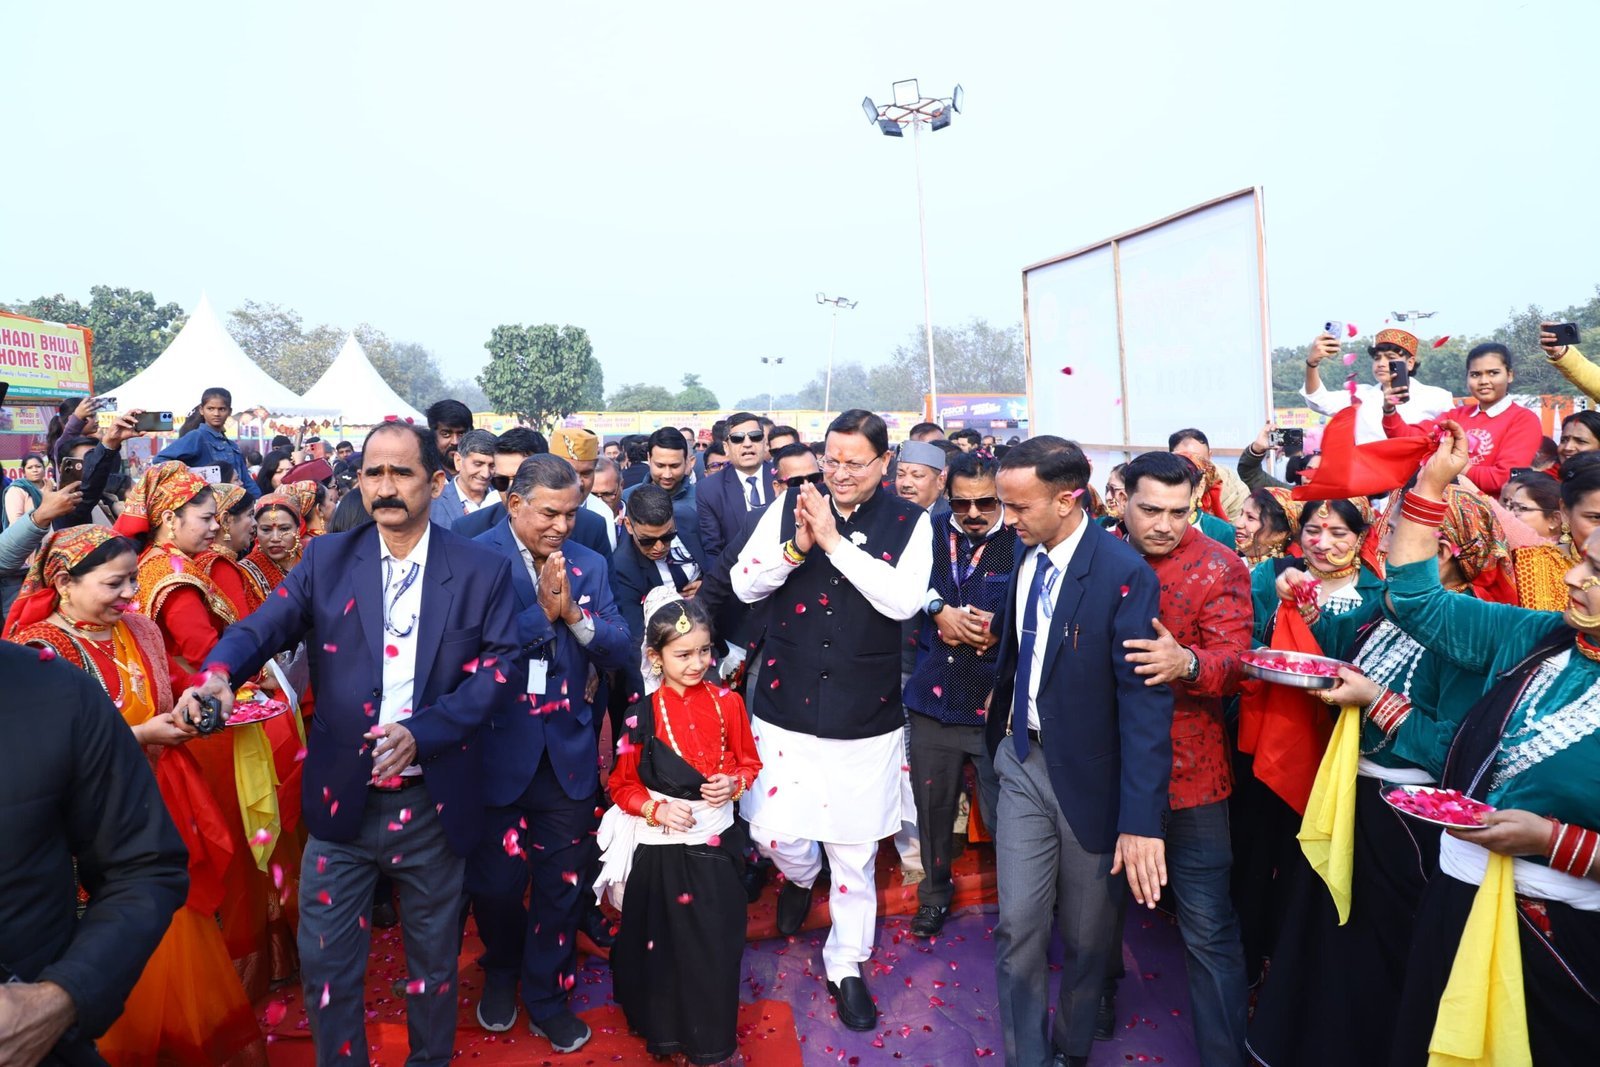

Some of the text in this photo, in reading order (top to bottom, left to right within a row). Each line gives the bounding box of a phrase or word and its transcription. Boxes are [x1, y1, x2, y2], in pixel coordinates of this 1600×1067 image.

[0, 328, 79, 355] HADI BHULA
[0, 348, 71, 371] HOME STAY
